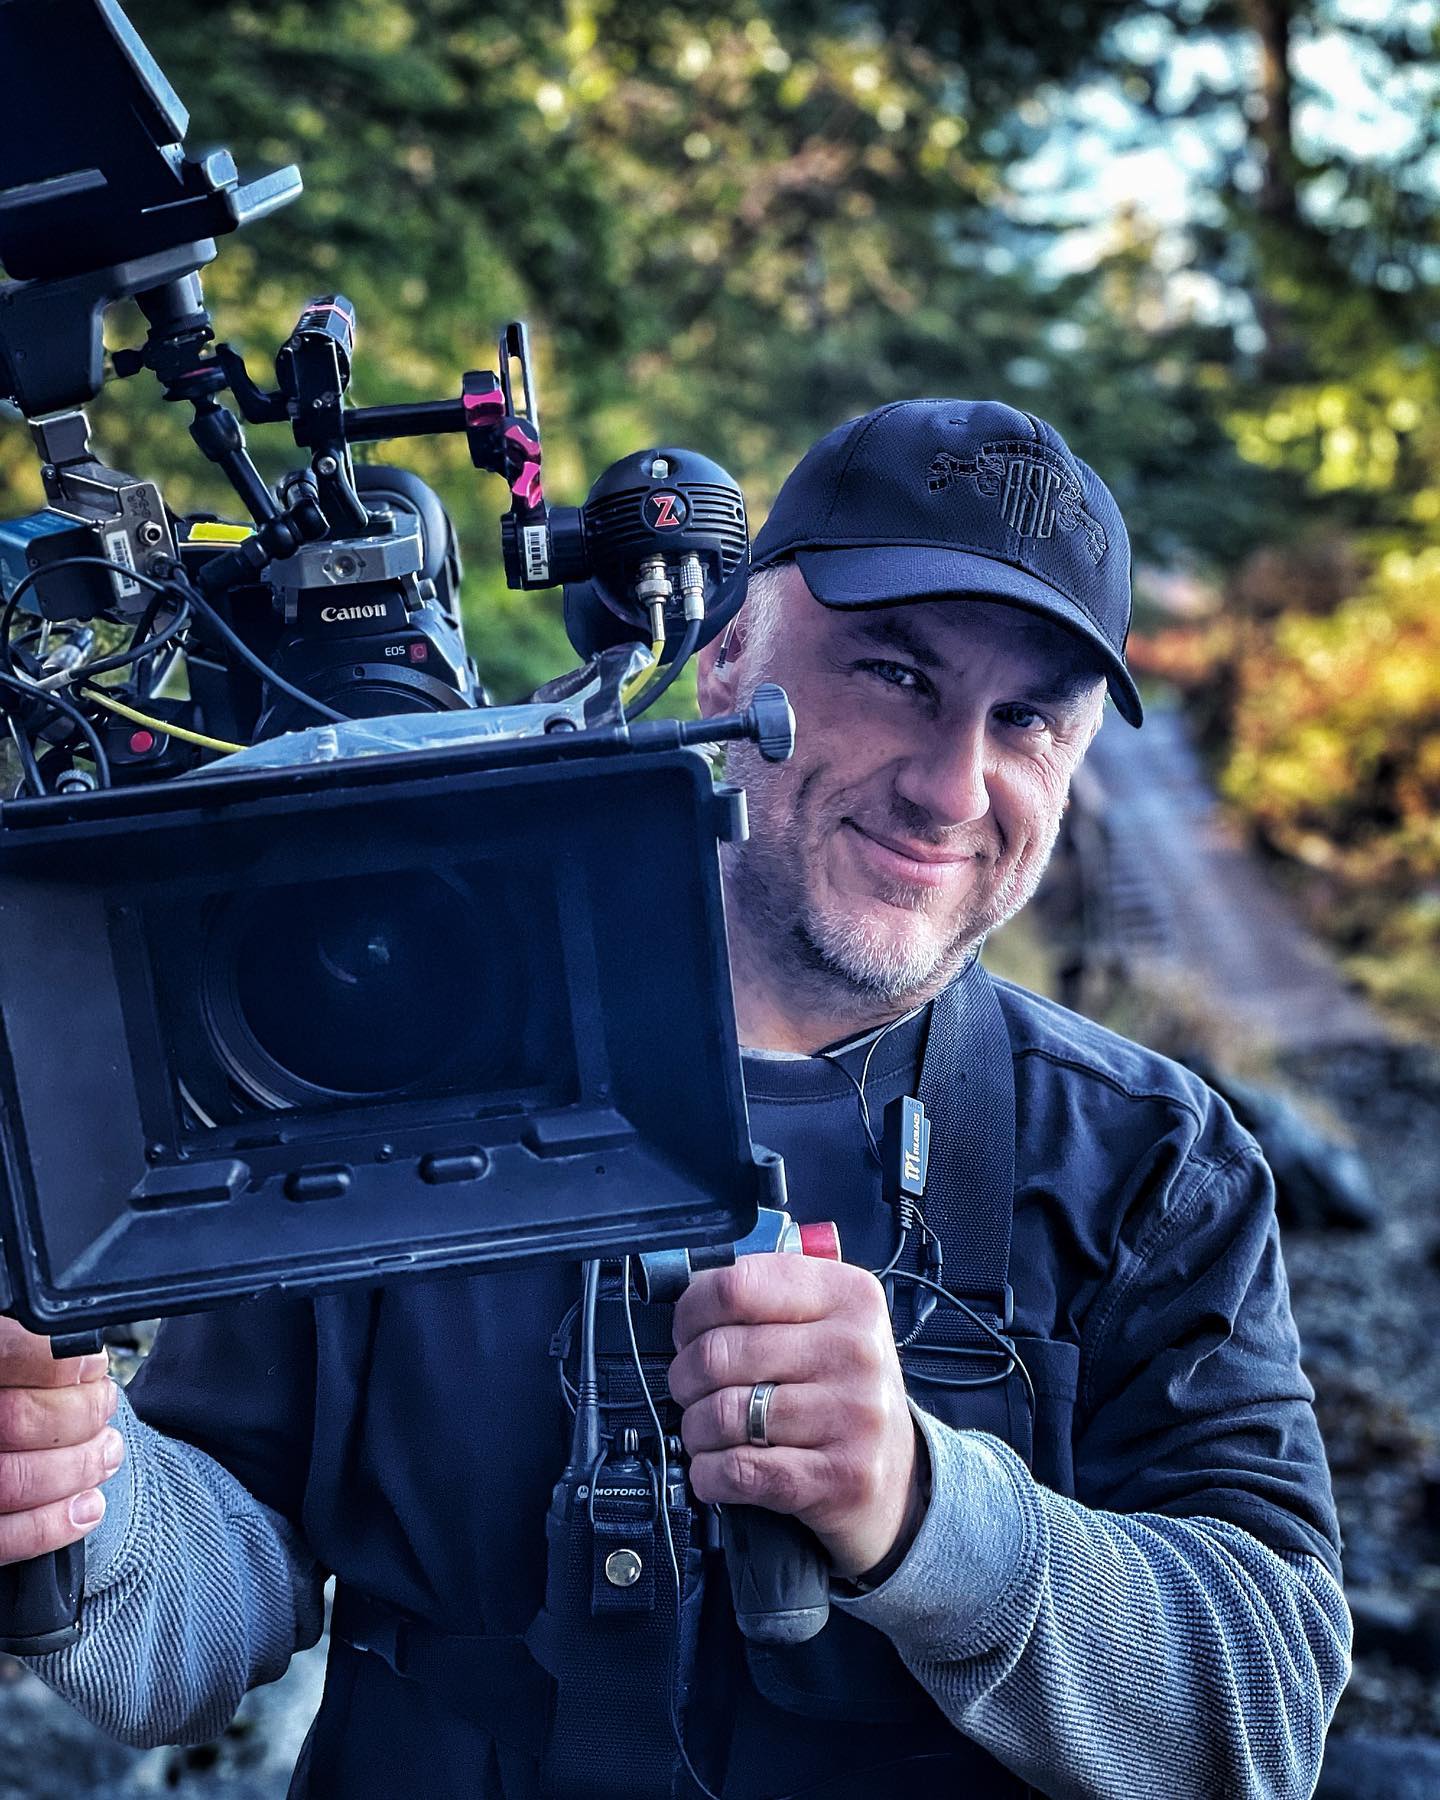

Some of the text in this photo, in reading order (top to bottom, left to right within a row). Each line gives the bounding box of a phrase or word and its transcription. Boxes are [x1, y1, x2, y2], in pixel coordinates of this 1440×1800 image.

[653, 496, 680, 527] Z
[321, 604, 387, 622] Canon
[385, 646, 425, 658] EOS C
[595, 1488, 653, 1496] MOTOROL
